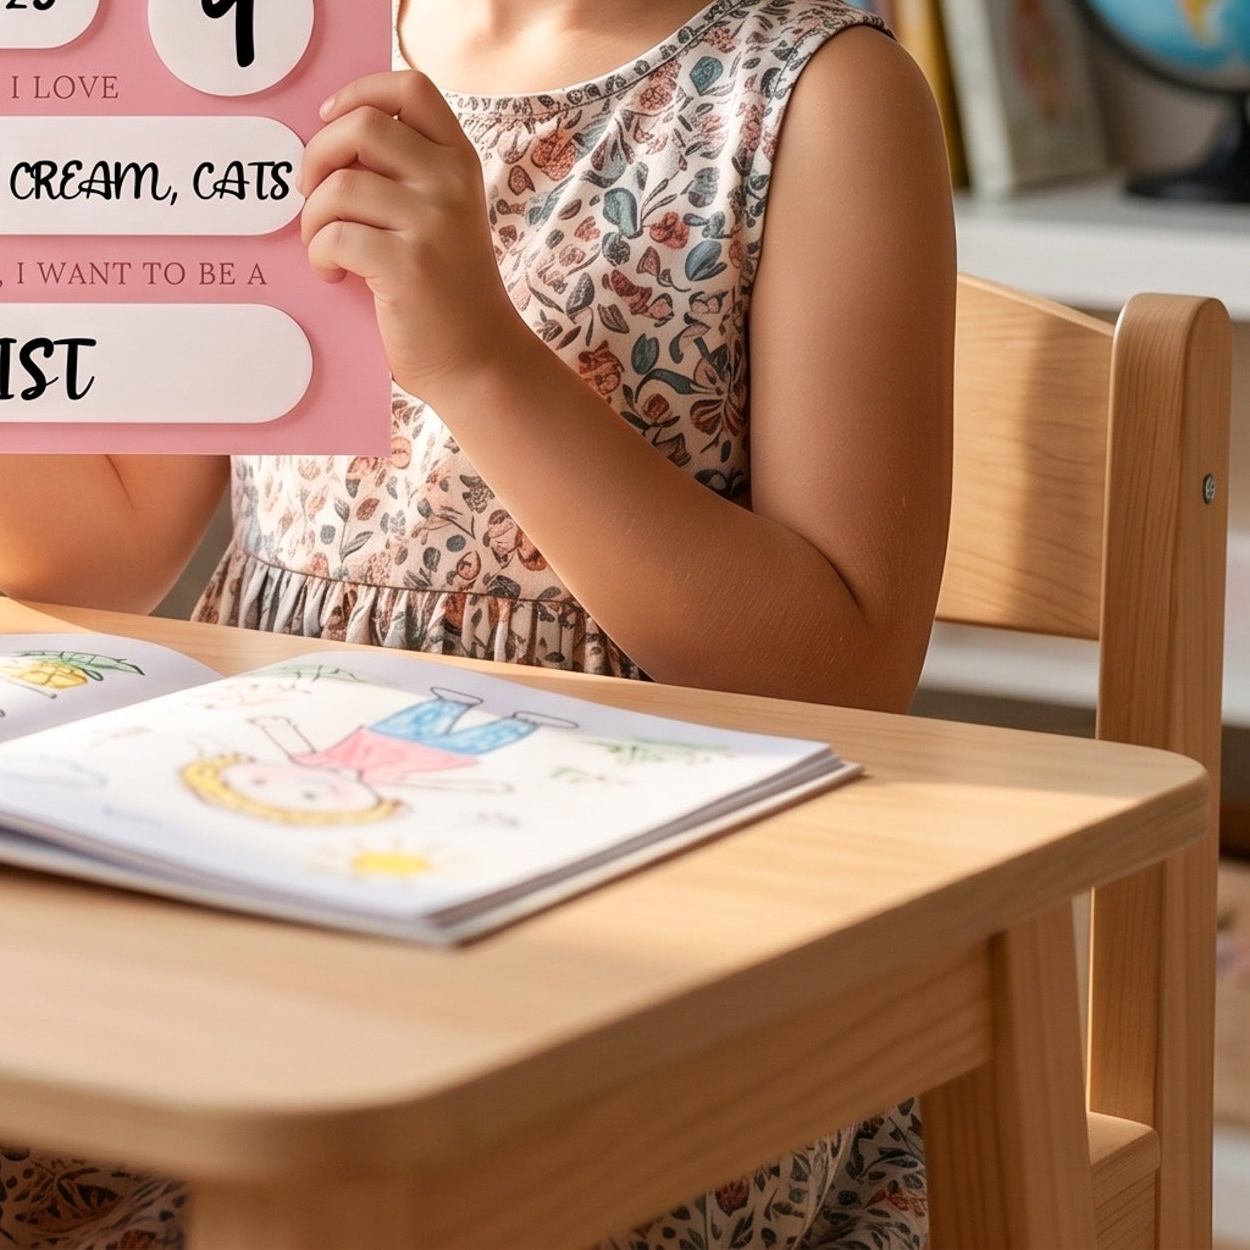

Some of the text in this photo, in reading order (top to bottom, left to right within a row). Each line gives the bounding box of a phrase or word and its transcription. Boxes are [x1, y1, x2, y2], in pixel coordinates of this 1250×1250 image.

[10, 75, 20, 100] I
[34, 75, 118, 99] LOVE
[10, 160, 177, 205] CREAM,
[193, 161, 293, 200] CATS
[16, 261, 25, 285] I
[37, 262, 132, 285] WANT
[143, 262, 185, 285] TO
[199, 262, 235, 285] BE
[247, 263, 267, 285] A
